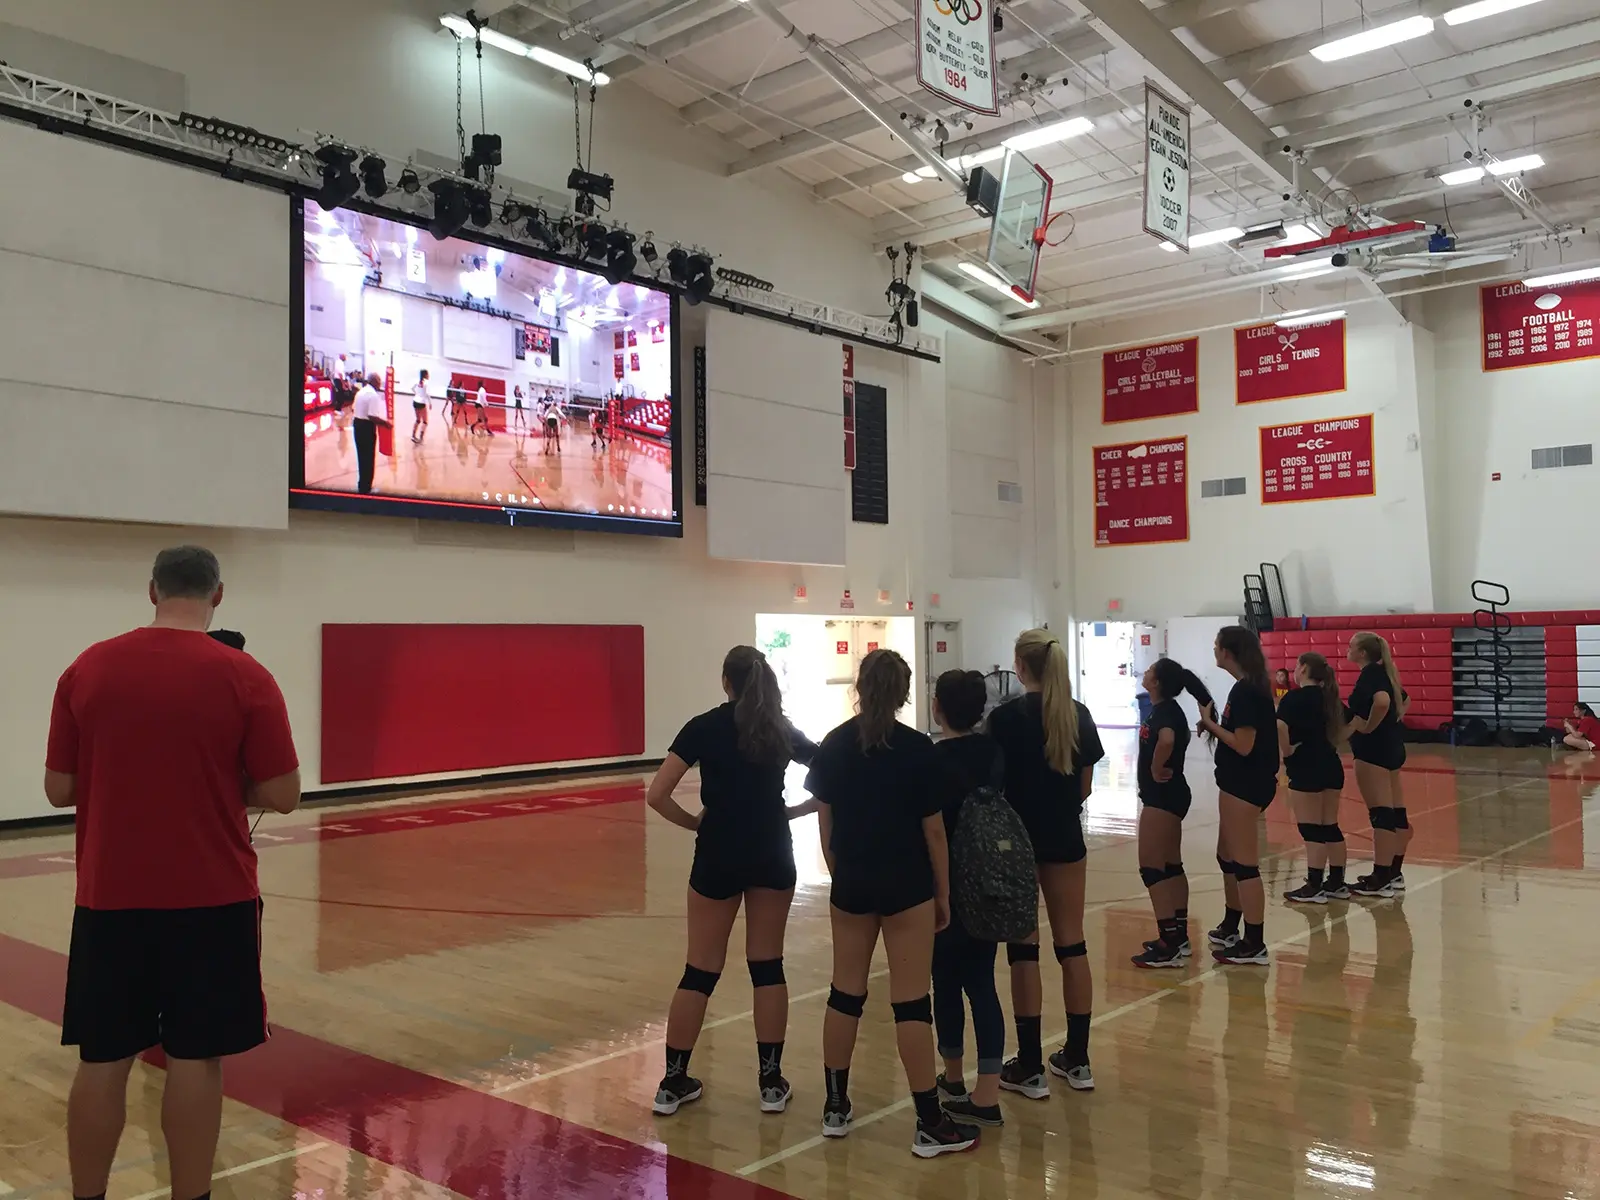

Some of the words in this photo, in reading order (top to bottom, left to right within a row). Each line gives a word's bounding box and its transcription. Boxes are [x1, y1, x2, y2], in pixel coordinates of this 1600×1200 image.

[944, 67, 967, 92] 1984
[1162, 214, 1178, 232] 2007
[1496, 284, 1534, 298] LEAGUE
[1522, 309, 1576, 328] FOOTBALL
[1531, 326, 1547, 334] 1965
[1554, 322, 1569, 331] 1972
[1577, 319, 1592, 328] 1974
[1246, 326, 1277, 339] LEAGUE
[1531, 335, 1547, 343] 1984
[1554, 332, 1569, 340] 1987
[1115, 350, 1140, 362] LEAGUE
[1146, 343, 1184, 356] CHAMPIONS
[1508, 348, 1524, 356] 2005
[1555, 341, 1570, 349] 2010
[1577, 338, 1593, 346] 2011
[1259, 353, 1282, 366] GIRLS
[1292, 347, 1320, 360] TENNIS
[1118, 375, 1137, 386] GIRLS
[1141, 369, 1182, 382] VOLLEYBALL
[1272, 425, 1303, 438] LEAGUE
[1314, 419, 1359, 433] CHAMPIONS
[1101, 449, 1122, 459] CHEER
[1149, 442, 1185, 454] CHAMPIONS
[1281, 456, 1307, 467] CROSS
[1314, 451, 1352, 464] COUNTRY
[1109, 519, 1130, 528] DANCE
[1134, 515, 1172, 526] CHAMPIONS
